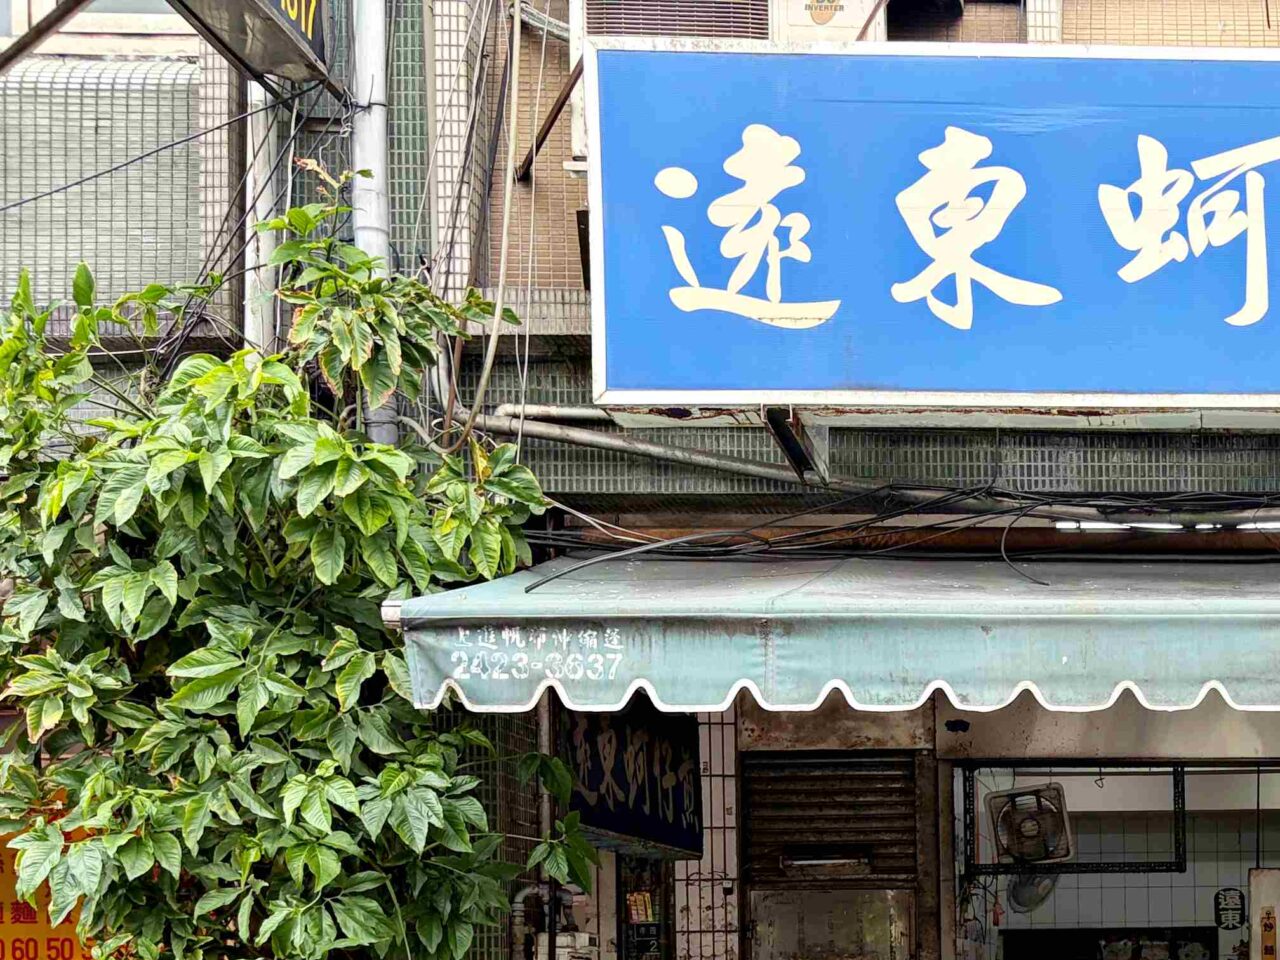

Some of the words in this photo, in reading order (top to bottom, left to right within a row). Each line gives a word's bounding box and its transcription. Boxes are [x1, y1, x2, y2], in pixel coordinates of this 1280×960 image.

[804, 4, 845, 12] INVERTER
[450, 652, 625, 680] 2423-3637
[1218, 889, 1243, 930] 遠東
